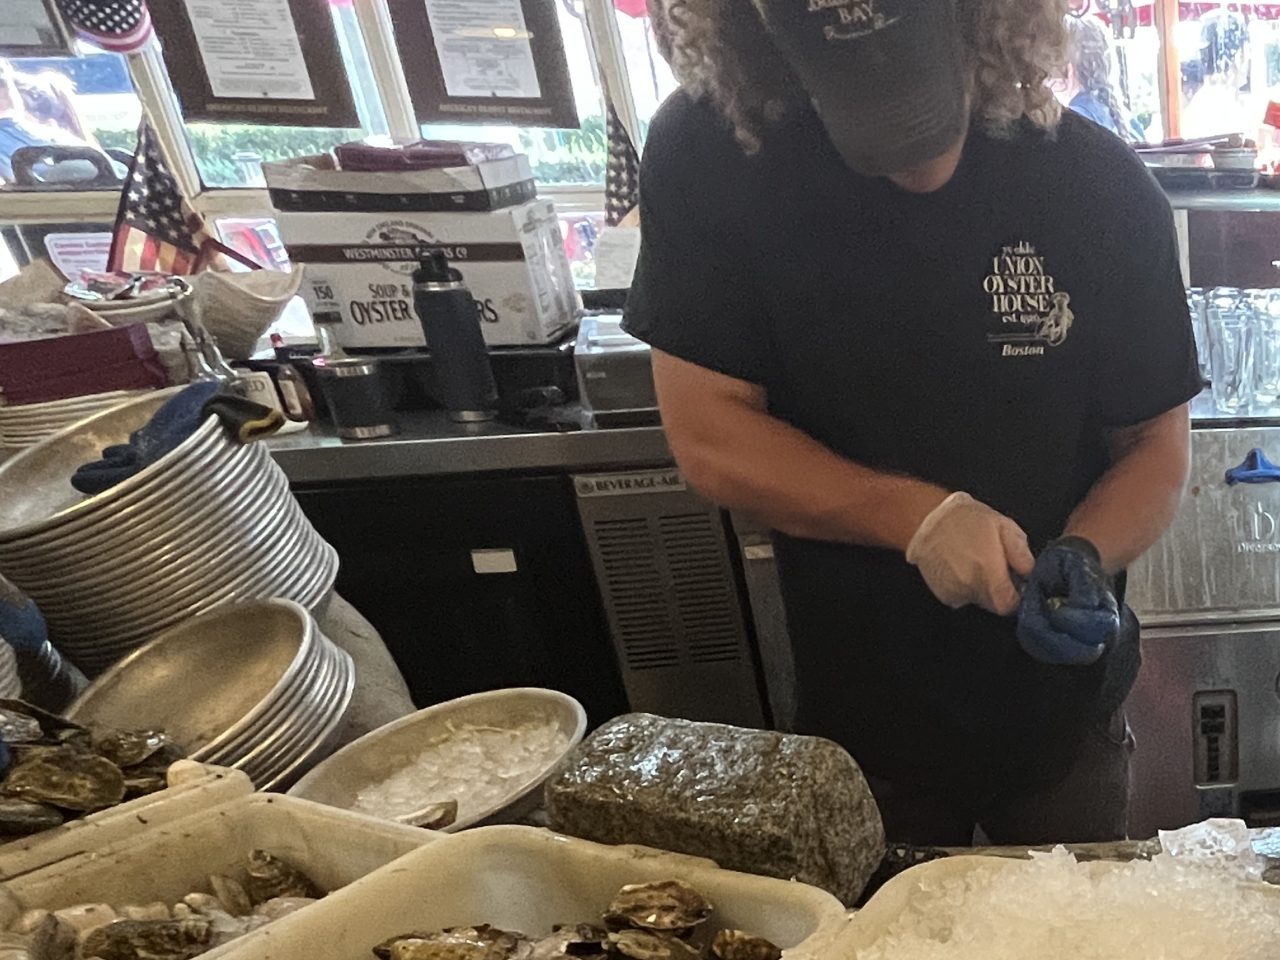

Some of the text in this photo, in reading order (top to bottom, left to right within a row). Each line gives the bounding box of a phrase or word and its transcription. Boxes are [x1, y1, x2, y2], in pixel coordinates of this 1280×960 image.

[343, 247, 413, 259] WESTMINSTER
[993, 256, 1044, 275] UNION
[368, 283, 397, 298] SOUP
[983, 275, 1054, 293] OYSTER
[313, 285, 334, 300] 150
[993, 294, 1050, 312] HOUSE
[350, 299, 412, 325] OYSTER
[1002, 344, 1044, 357] Boston
